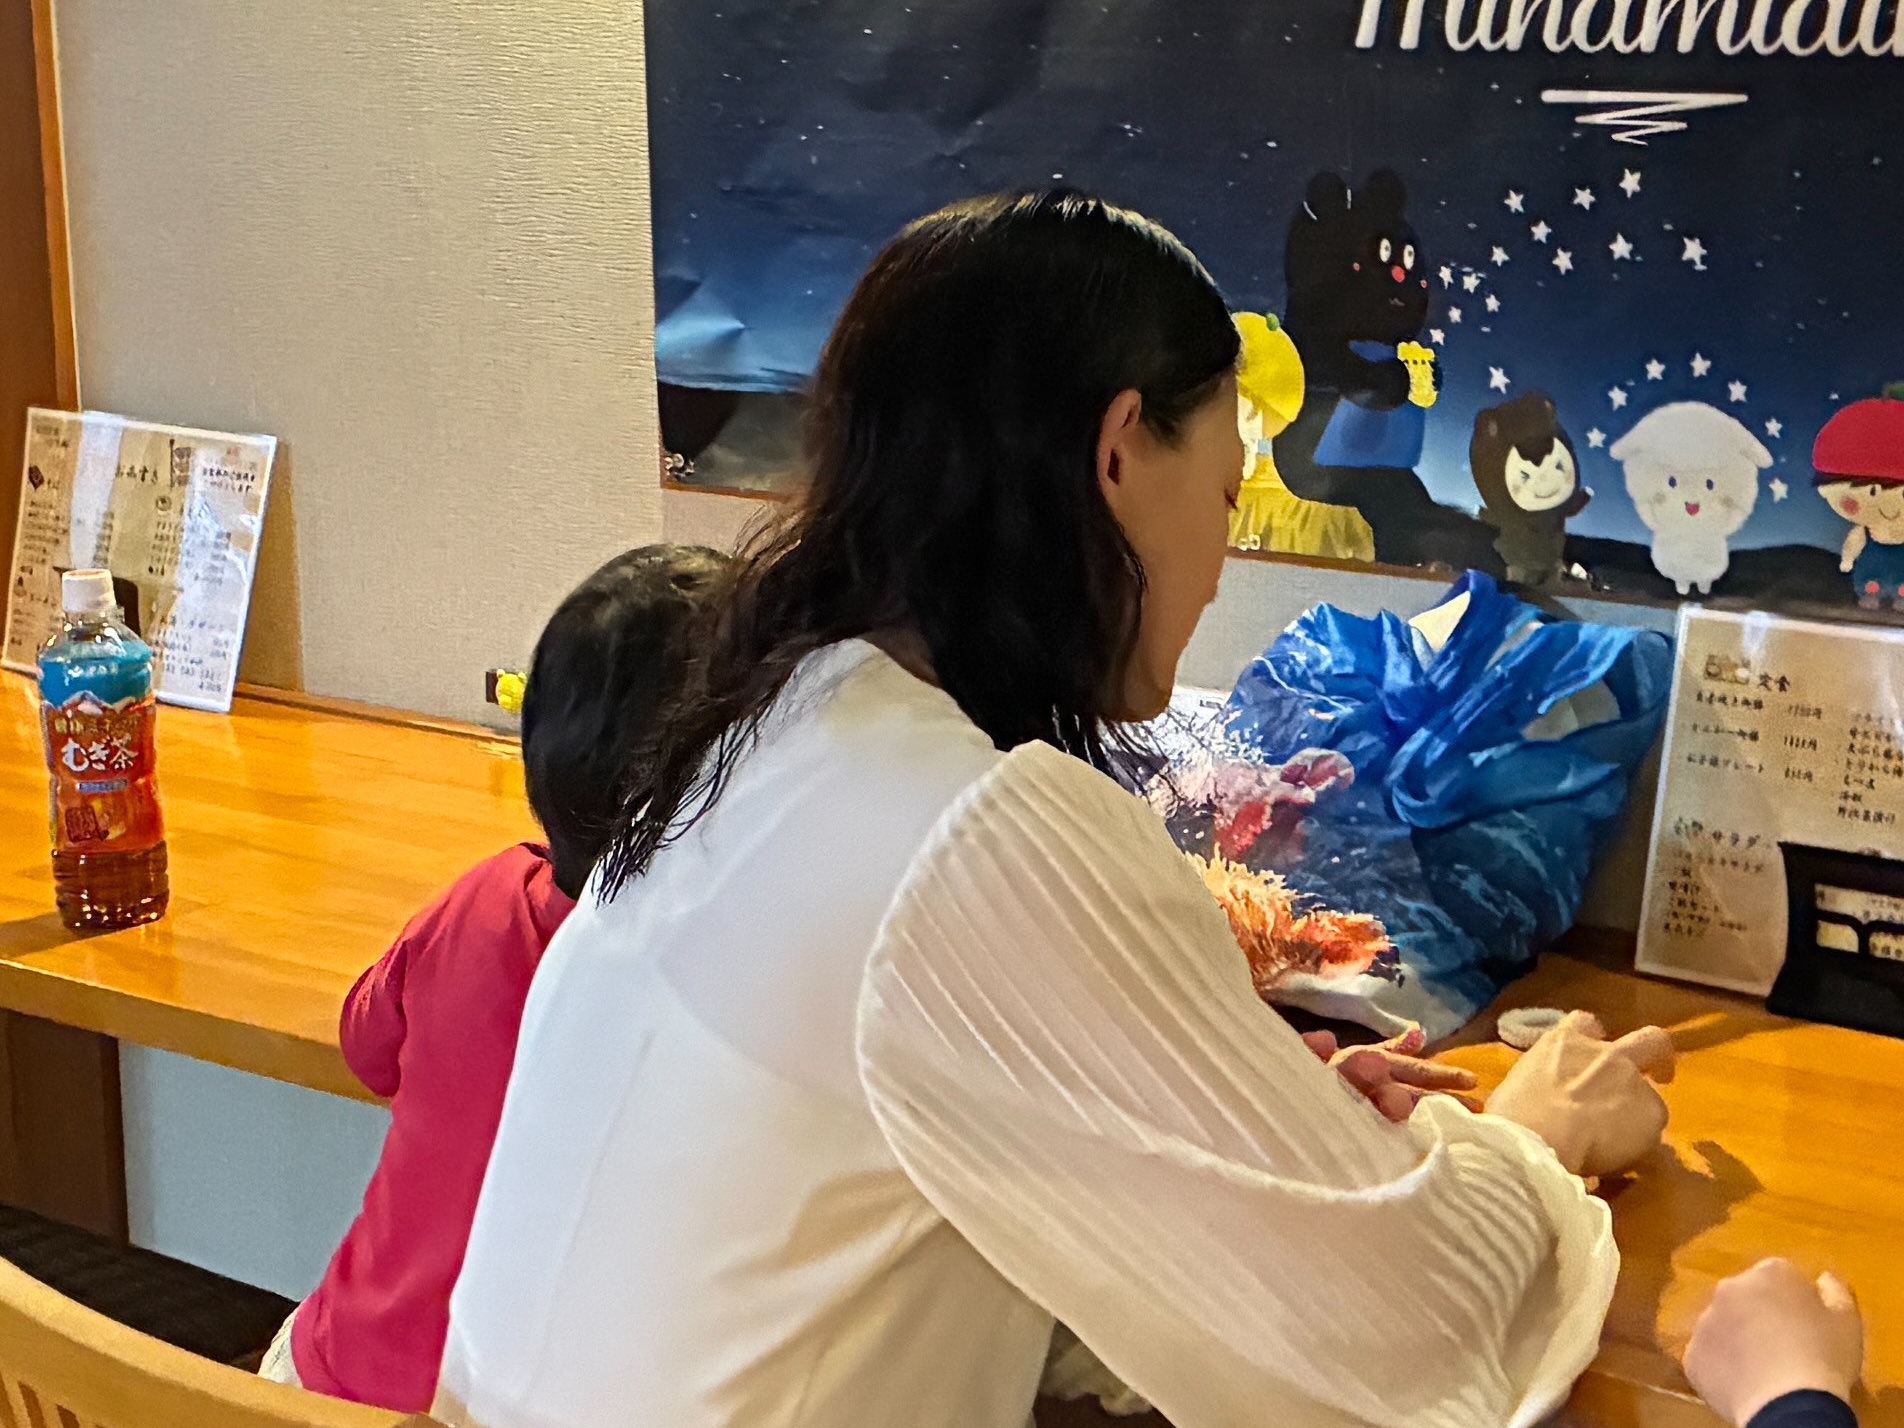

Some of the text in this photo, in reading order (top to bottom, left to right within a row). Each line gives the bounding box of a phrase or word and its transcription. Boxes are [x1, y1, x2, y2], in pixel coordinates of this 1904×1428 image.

[1756, 671, 1791, 693] 定食
[61, 732, 140, 773] むぎ茶
